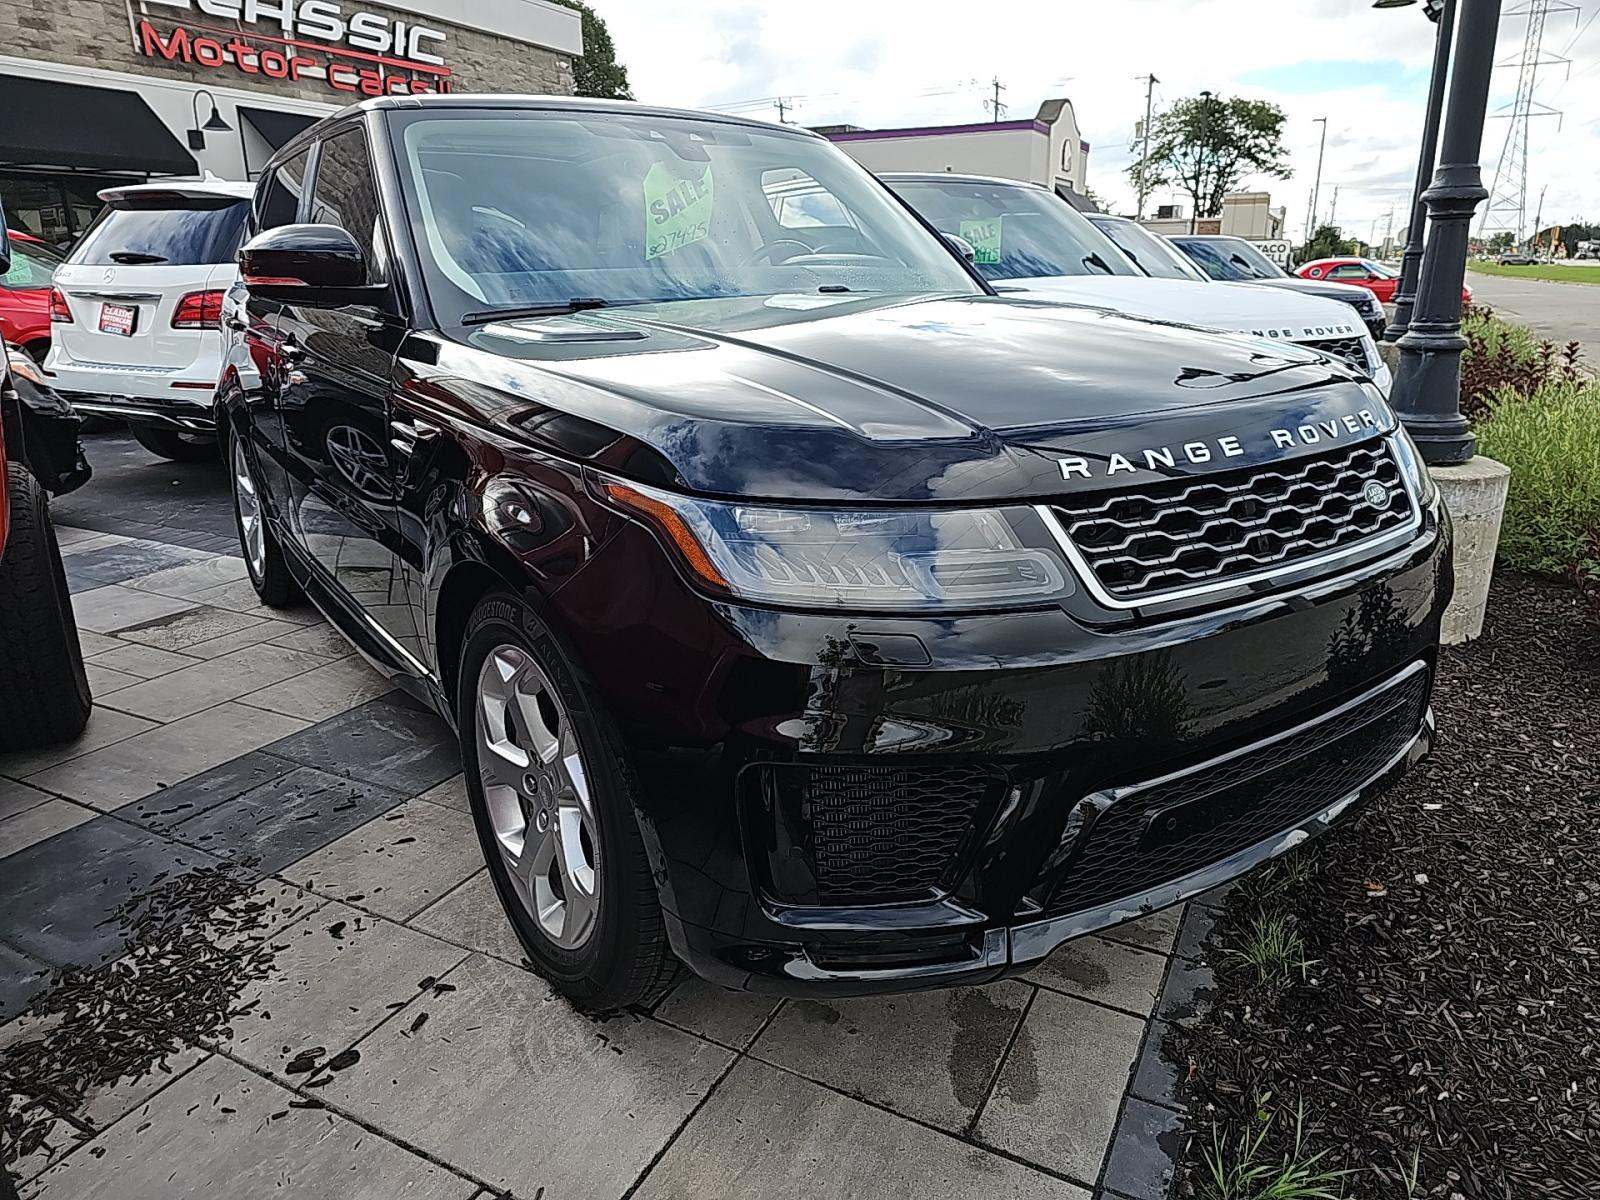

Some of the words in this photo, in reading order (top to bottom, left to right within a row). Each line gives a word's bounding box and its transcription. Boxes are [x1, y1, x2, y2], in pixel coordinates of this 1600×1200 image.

[138, 0, 447, 66] LASSIC
[650, 180, 709, 225] SALE
[964, 224, 996, 243] SALE
[1303, 325, 1353, 336] ROVER
[1058, 435, 1244, 480] RANGE
[1270, 409, 1376, 448] ROVER
